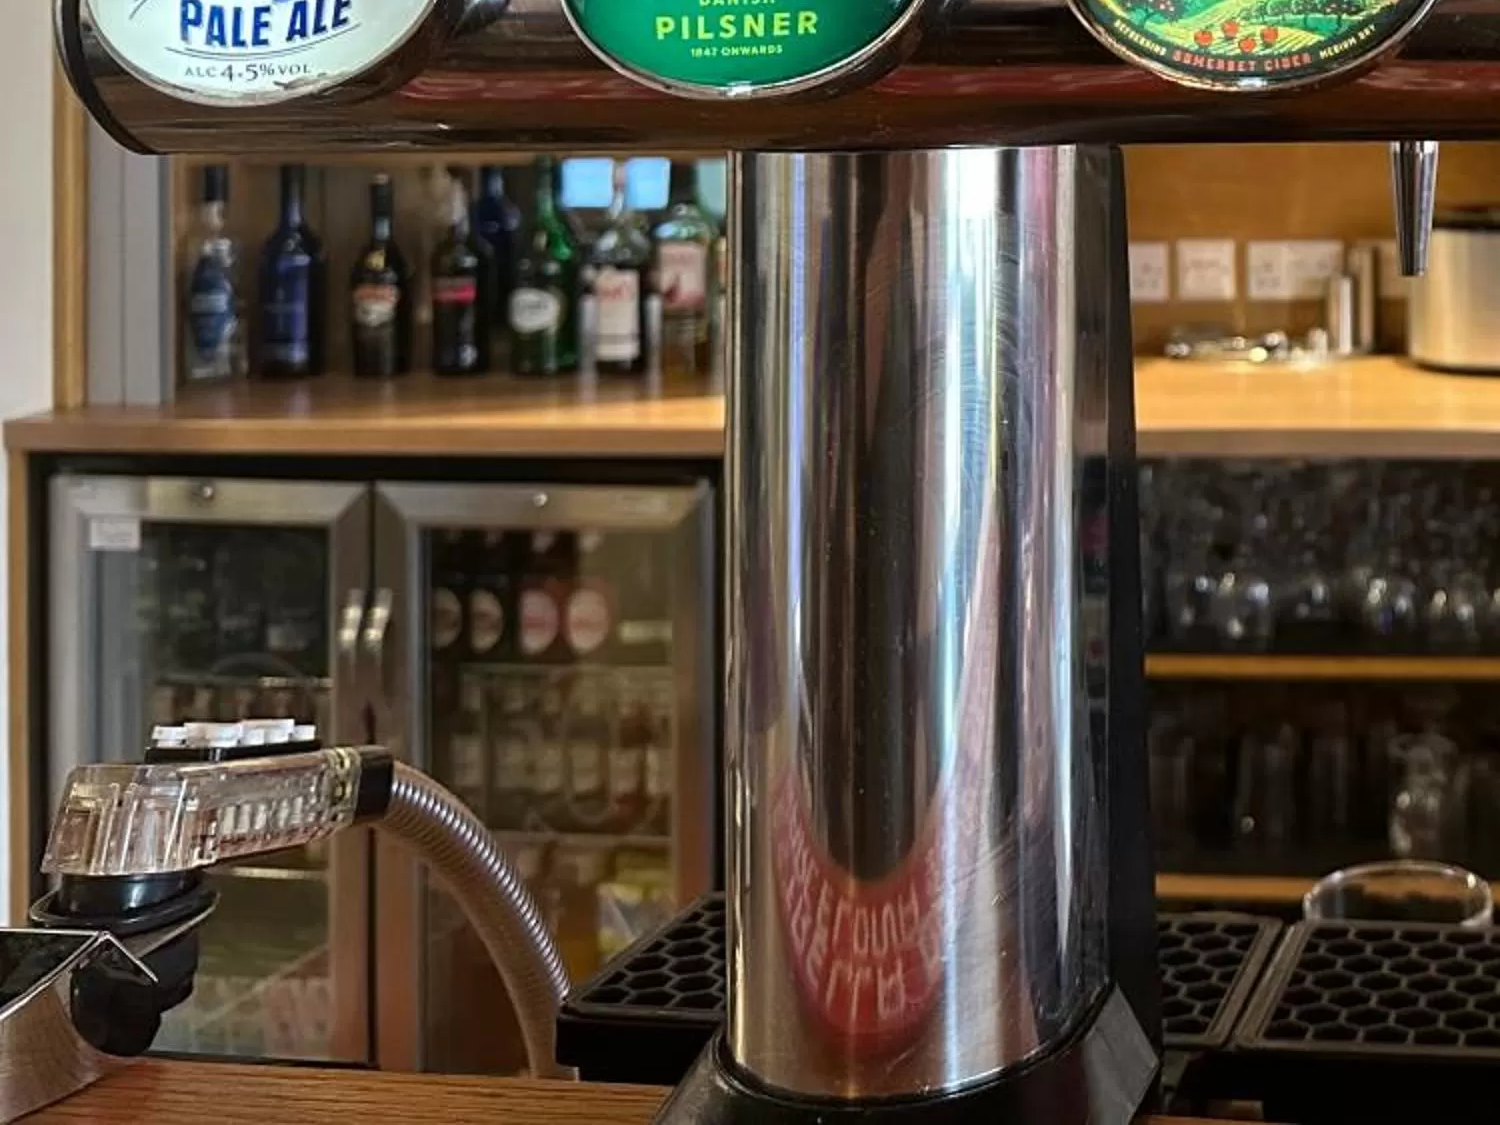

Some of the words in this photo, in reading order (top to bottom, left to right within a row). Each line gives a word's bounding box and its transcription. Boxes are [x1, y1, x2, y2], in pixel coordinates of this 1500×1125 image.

[655, 10, 818, 40] PILSNER
[721, 44, 783, 57] ONWARDS
[184, 66, 217, 78] ALC
[278, 63, 311, 76] VOL
